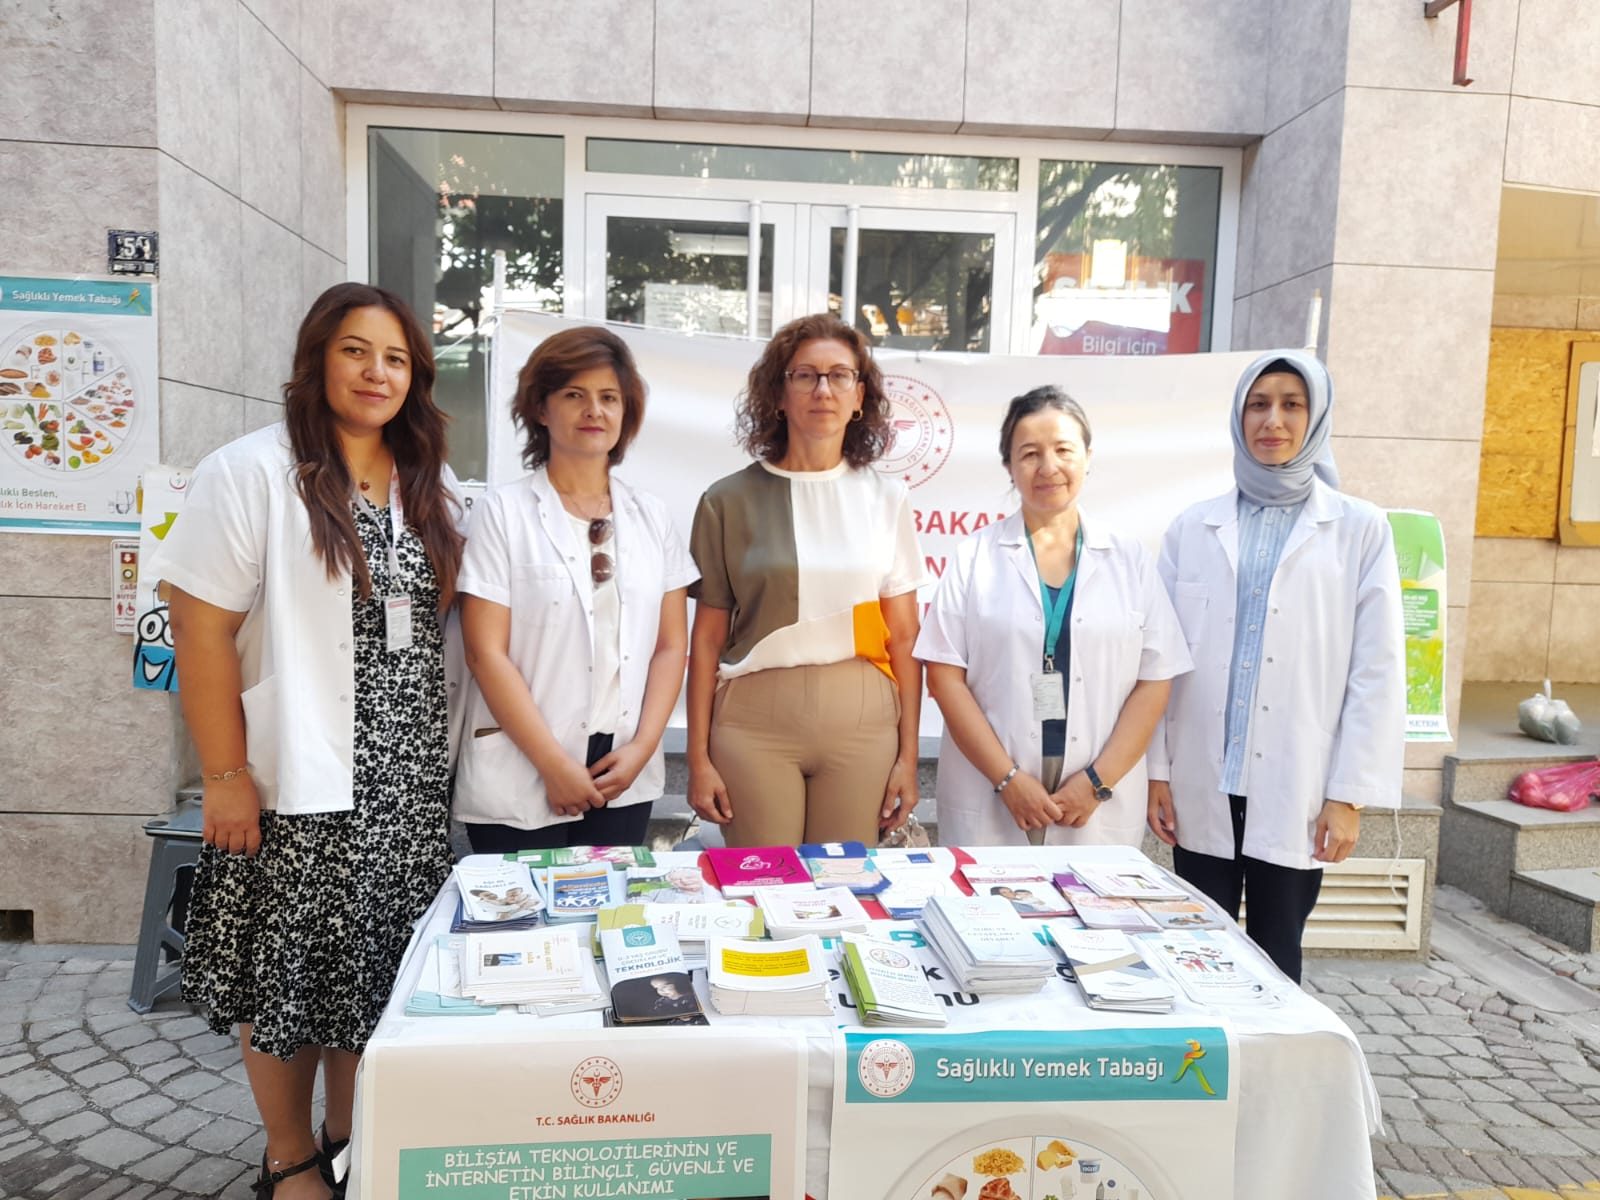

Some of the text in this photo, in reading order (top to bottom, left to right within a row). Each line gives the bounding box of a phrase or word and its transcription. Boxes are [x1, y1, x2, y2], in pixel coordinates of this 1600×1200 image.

[12, 290, 122, 306] Sağlıklı Yemek Tabağı
[1083, 336, 1121, 354] Bilgi
[22, 488, 58, 498] Beslen,
[36, 501, 74, 511] Hareket
[77, 503, 87, 512] Et
[615, 956, 681, 973] TEKNOLOJİK
[936, 1057, 1164, 1082] Sağlıklı Yemek Tabağı
[536, 1112, 656, 1127] T.C. SAĞLIK BAKANLIĞI
[444, 1140, 738, 1169] BİLİŞİM TEKNOLOJİLERİNİN VE
[425, 1157, 754, 1188] İNTERNETİN BİLİNÇLİ, GÜVENLİ VE
[509, 1179, 675, 1200] ETKİN KULLANIMI
